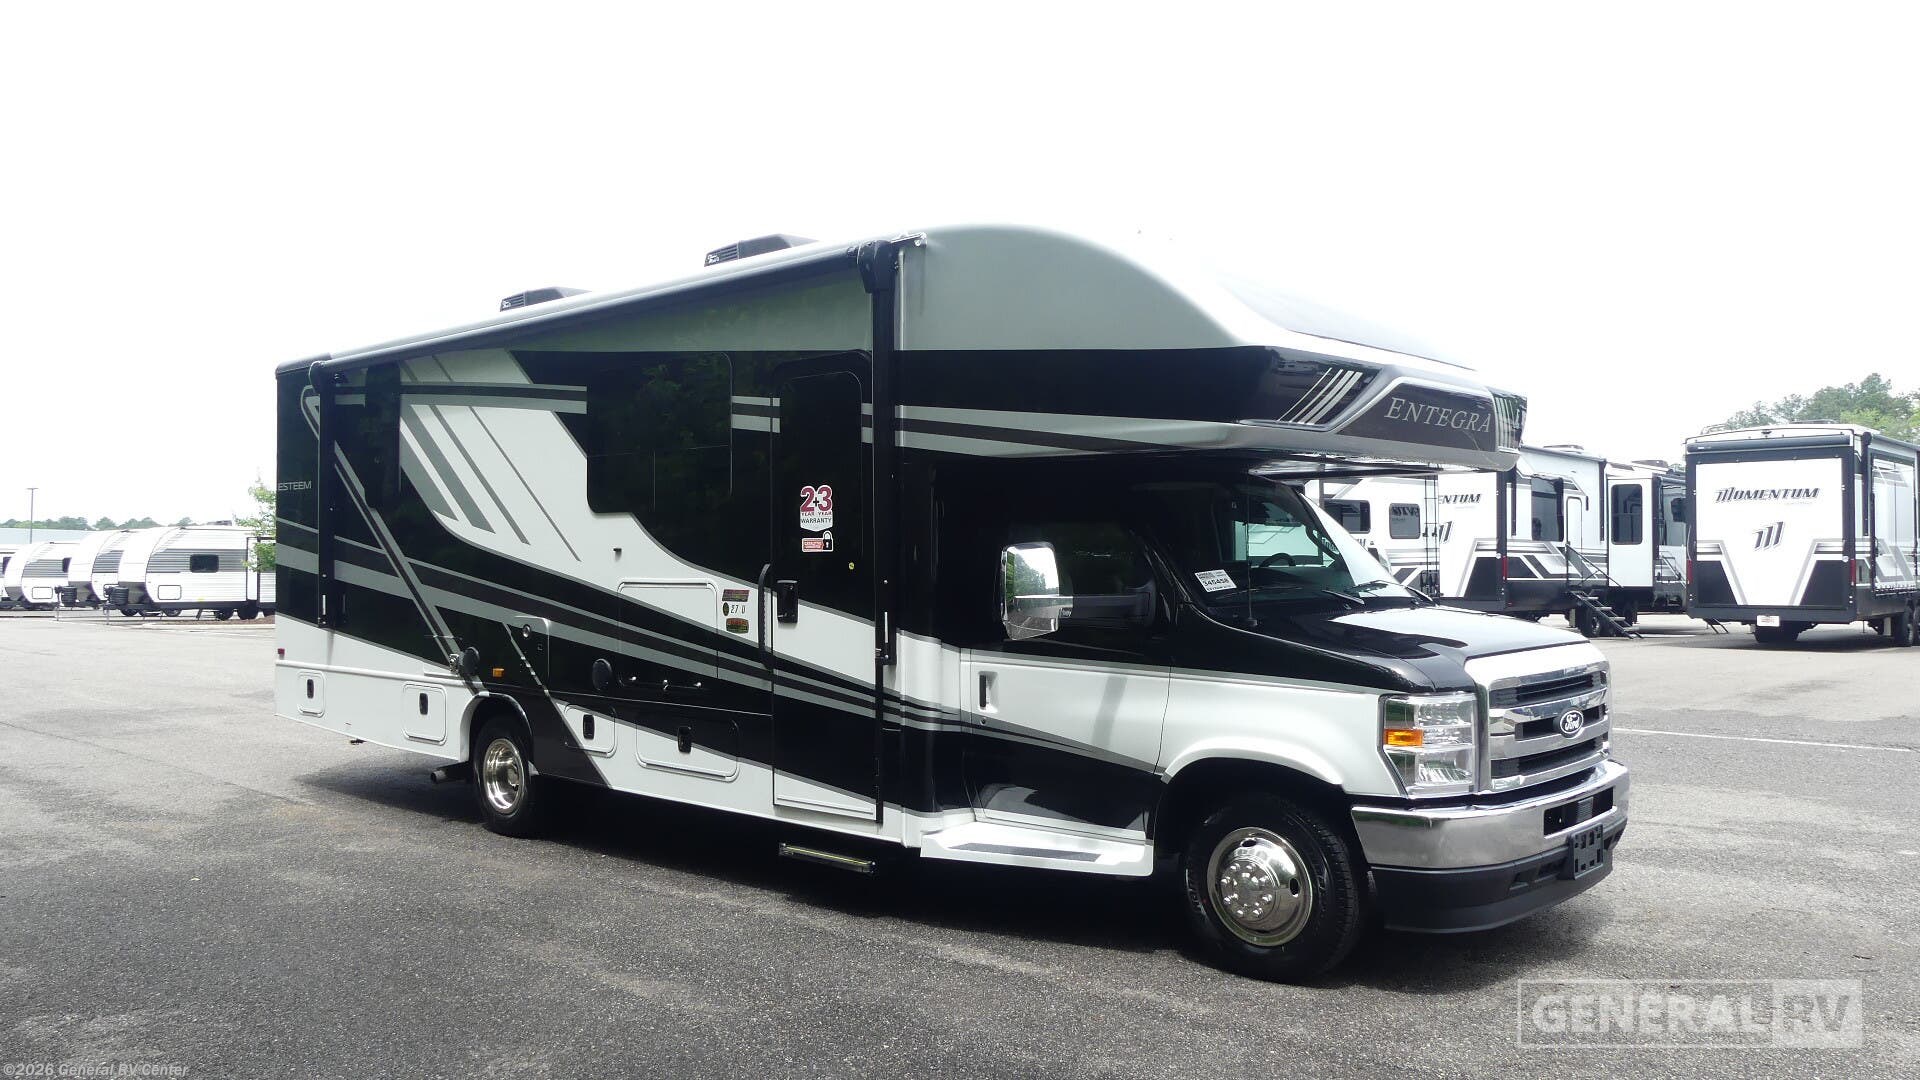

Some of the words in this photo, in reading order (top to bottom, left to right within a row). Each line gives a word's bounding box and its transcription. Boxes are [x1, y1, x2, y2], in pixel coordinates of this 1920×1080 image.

[1384, 397, 1491, 432] ENTEGRA
[277, 481, 312, 491] ESTEEM
[1715, 487, 1820, 503] MOMENTUM
